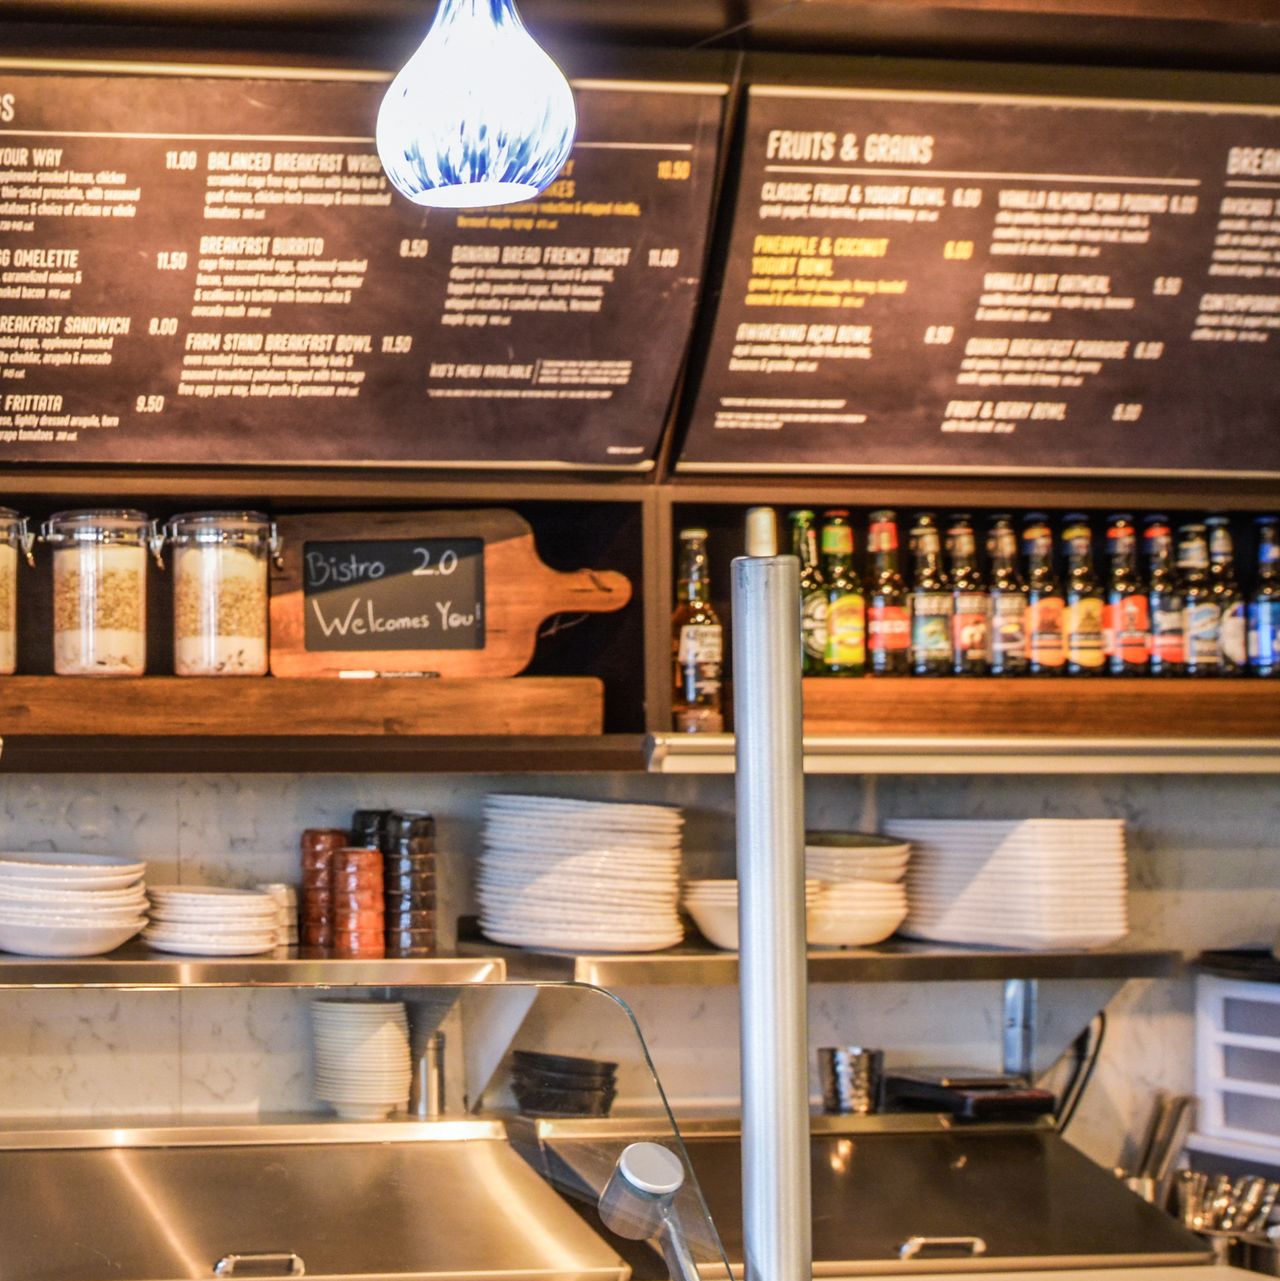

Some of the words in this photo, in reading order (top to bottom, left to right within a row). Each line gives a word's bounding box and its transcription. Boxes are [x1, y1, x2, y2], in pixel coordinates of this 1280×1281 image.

[767, 130, 837, 160] FRUITS
[840, 133, 858, 161] &
[864, 133, 934, 164] GRAINS
[32, 149, 63, 166] WAY
[166, 151, 197, 170] 11.00
[207, 152, 271, 171] BALANCED
[274, 152, 344, 172] BREAKFAST
[200, 236, 271, 254] BREAKFAST
[272, 237, 324, 256] BURRITO
[14, 250, 79, 268] OMELETTE
[157, 252, 187, 270] 11.50
[64, 317, 130, 335] SANDWICH
[149, 318, 178, 335] 8.00
[185, 333, 221, 350] FARM
[223, 334, 263, 351] STAND
[264, 334, 334, 352] BREAKFAST
[336, 335, 372, 353] BOWL
[382, 336, 412, 353] 11.50
[4, 395, 63, 412] FRITTATA
[136, 395, 164, 413] 9.50
[306, 551, 385, 586] Bistro
[412, 547, 458, 577] 2.0
[312, 598, 430, 638] Welcomes
[435, 601, 481, 631] You!
